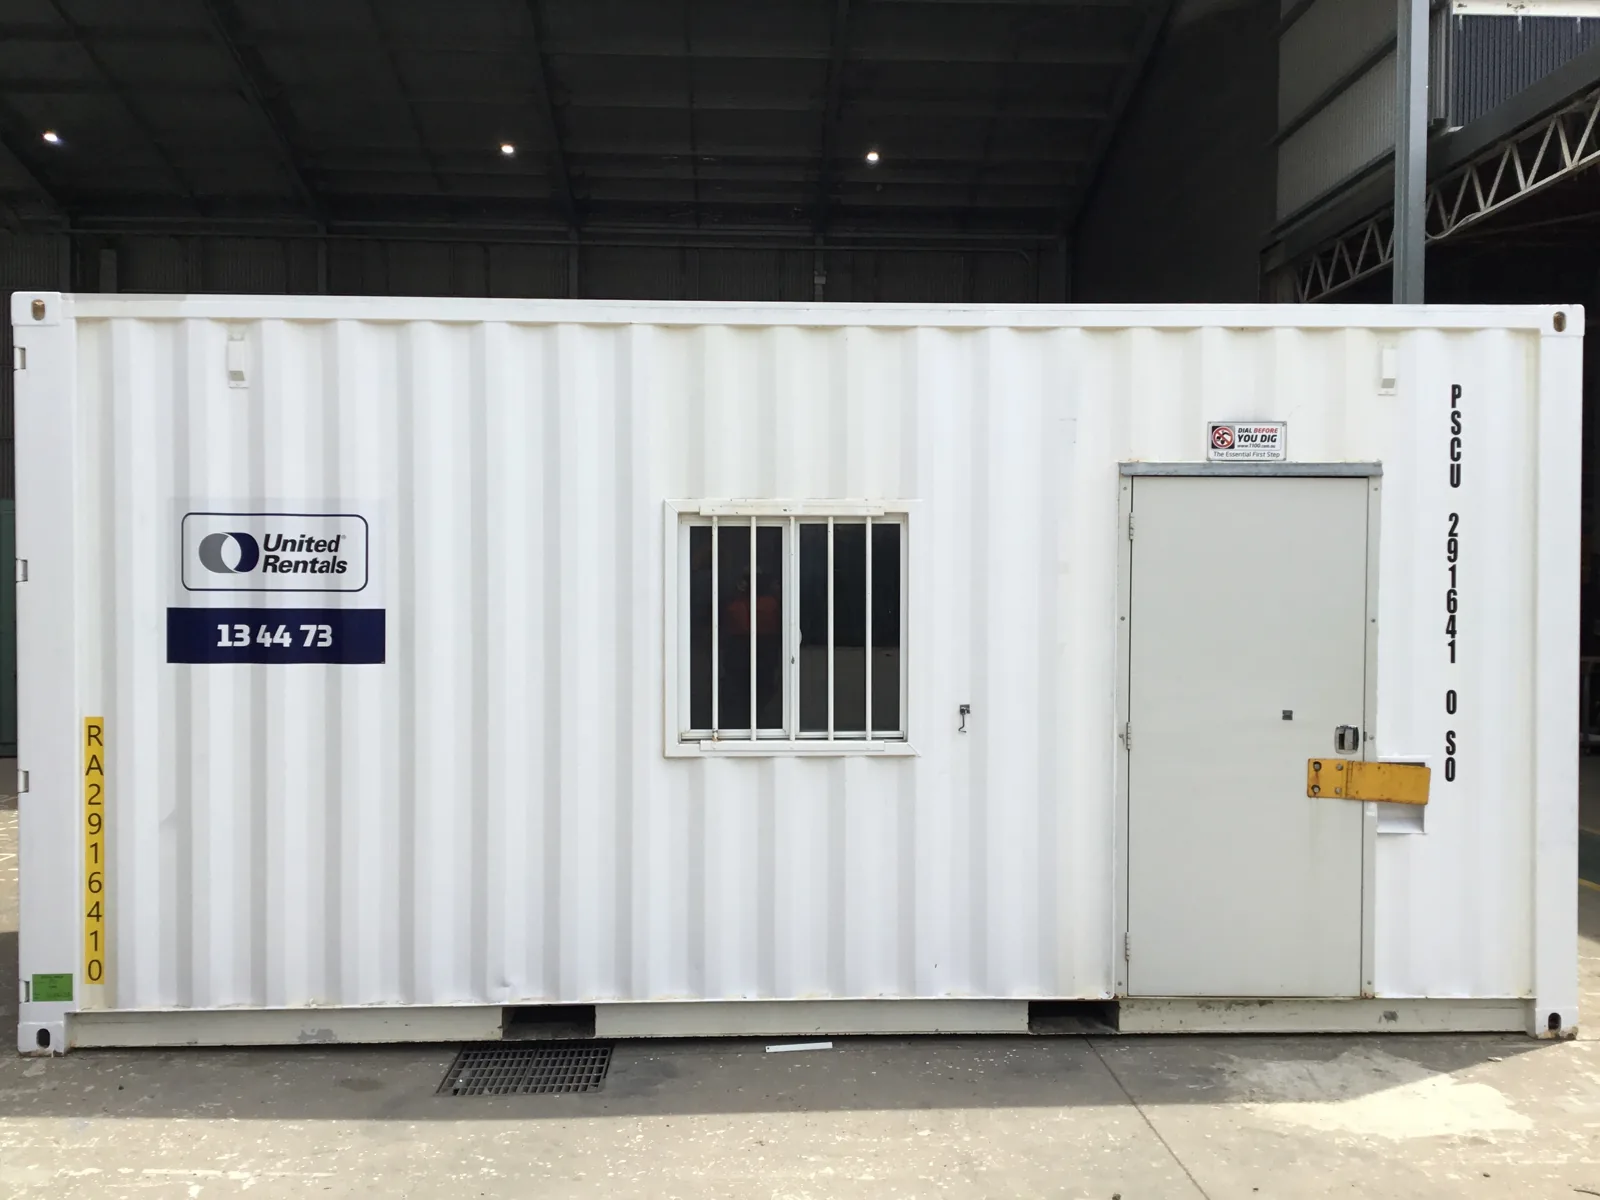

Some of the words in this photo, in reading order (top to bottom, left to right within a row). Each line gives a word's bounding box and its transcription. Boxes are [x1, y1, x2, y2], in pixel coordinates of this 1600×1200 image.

[1237, 434, 1258, 442] YOU
[1260, 434, 1277, 442] DIG
[1449, 384, 1462, 489] PSCU
[1266, 451, 1280, 459] Step
[263, 533, 341, 553] United
[262, 555, 348, 574] Rentals
[1445, 512, 1460, 664] 291641
[216, 624, 251, 647] 13
[256, 624, 293, 648] 44
[299, 624, 333, 648] 73
[85, 724, 104, 982] RA2916410
